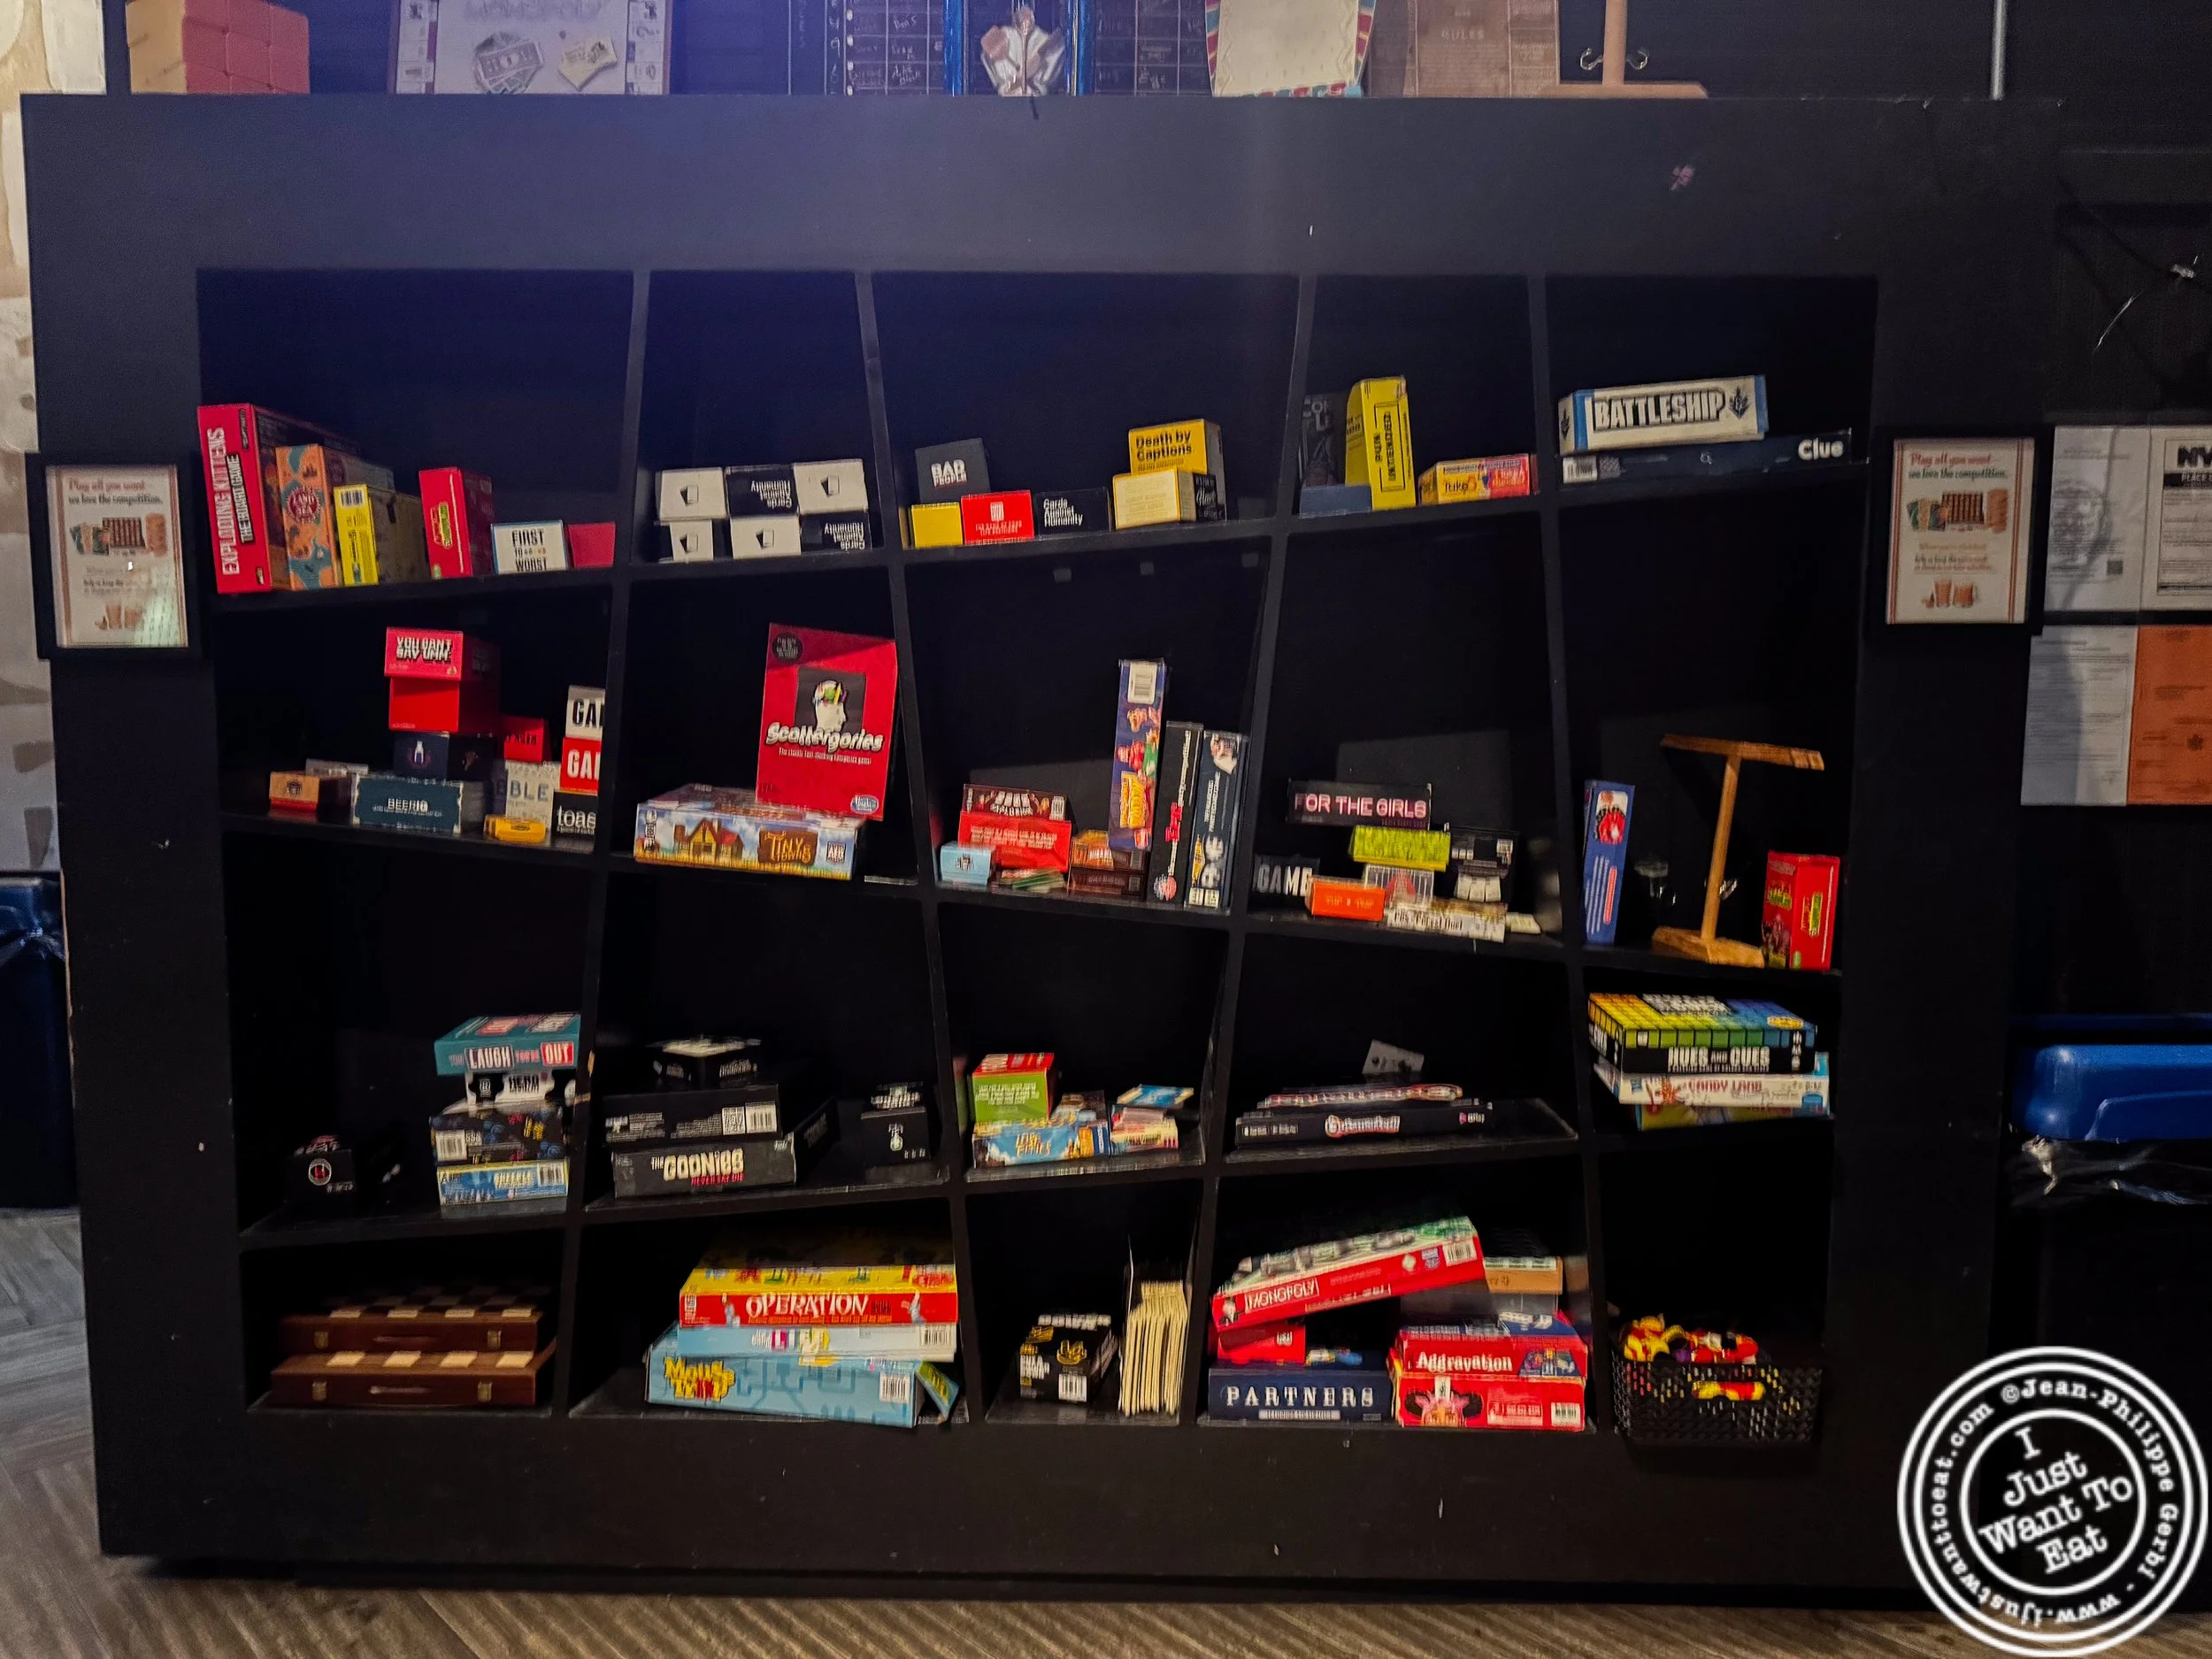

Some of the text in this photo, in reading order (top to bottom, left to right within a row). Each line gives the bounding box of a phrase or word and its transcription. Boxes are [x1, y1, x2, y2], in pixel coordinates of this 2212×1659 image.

[1594, 389, 1726, 430] BATTLESHIP
[1135, 428, 1192, 449] Death by
[1797, 437, 1845, 461] Clue
[1136, 444, 1193, 462] Captions
[227, 454, 244, 487] GAME
[206, 426, 240, 576] EXPLODING KITTENS
[240, 520, 254, 543] THE
[765, 721, 884, 753] Scattergories
[1294, 793, 1427, 819] FOR THE GIRLS
[468, 1045, 512, 1070] LAUGH
[544, 1043, 570, 1065] OUT
[1668, 1046, 1709, 1067] HUES
[1730, 1046, 1770, 1067] CUES
[1688, 1079, 1763, 1093] CANDY LAND
[650, 1147, 745, 1183] THE GOONIES
[731, 1171, 745, 1183] DIE
[745, 1291, 869, 1317] OPERATION
[1247, 1279, 1317, 1312] MONOPOLY
[1415, 1351, 1514, 1373] Aggravation
[1225, 1385, 1374, 1408] PARTNERS
